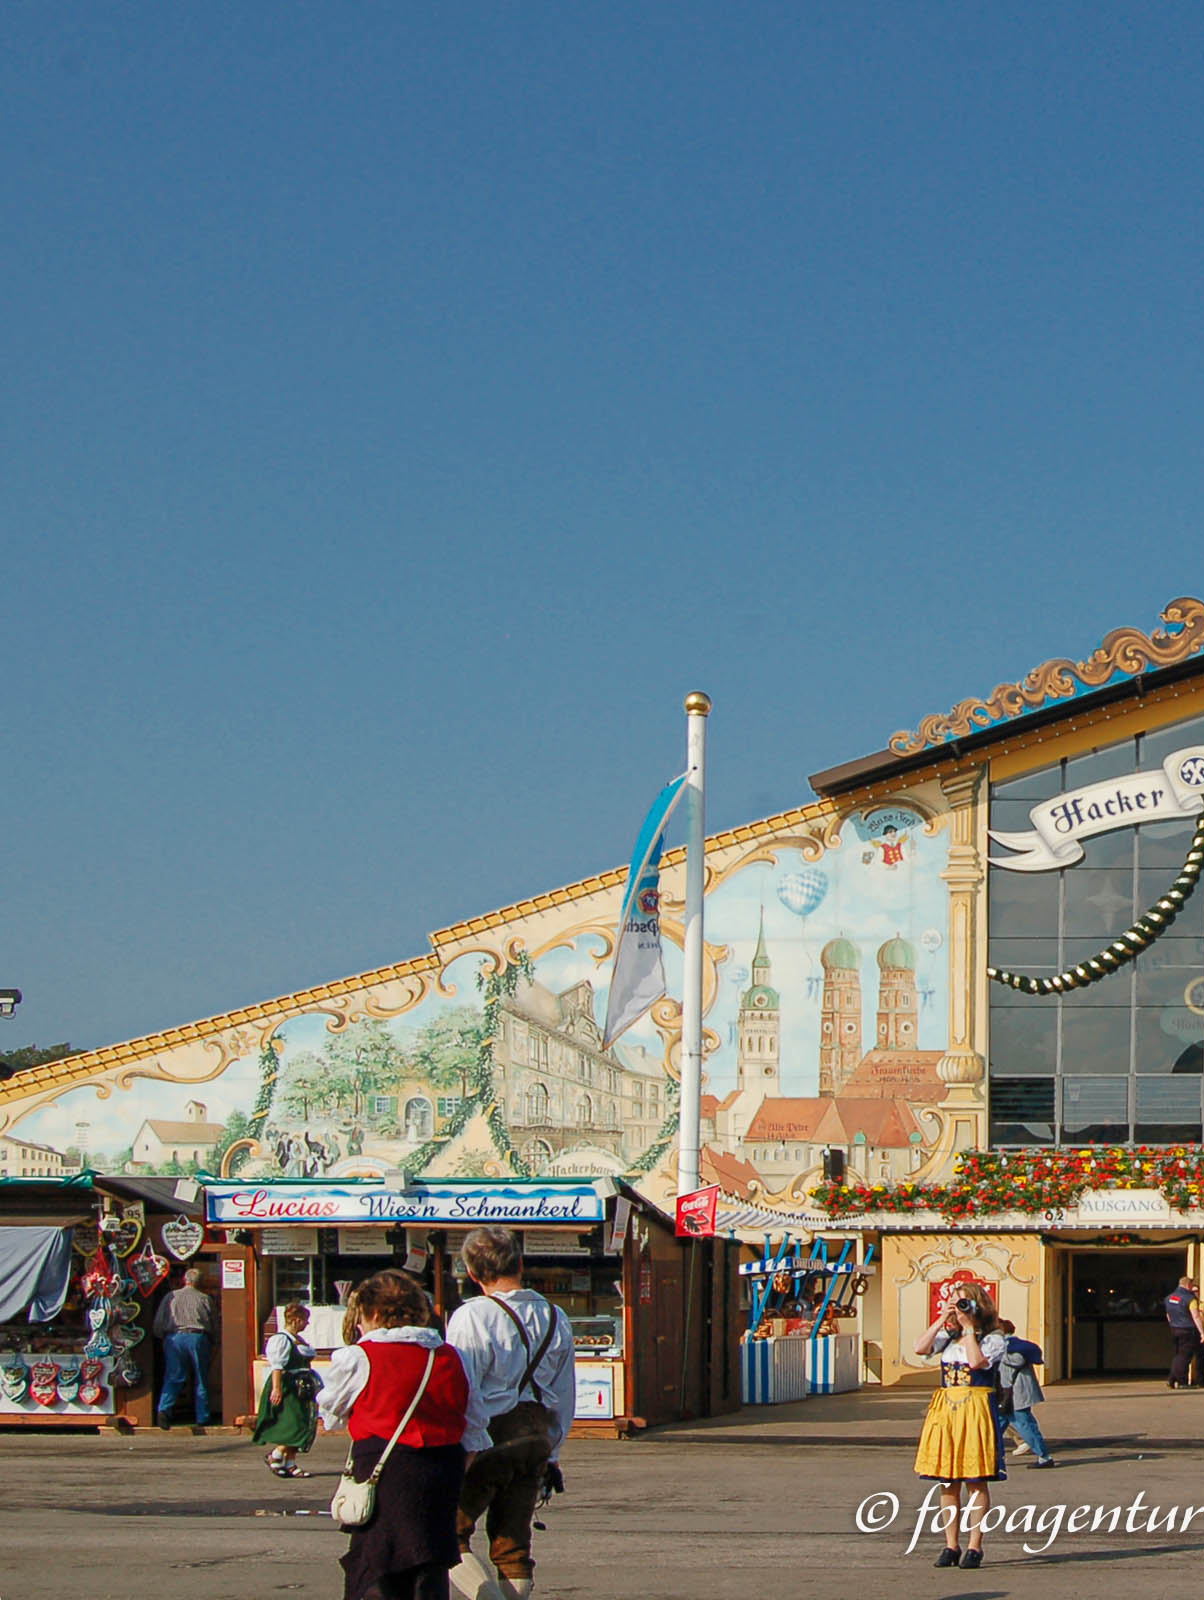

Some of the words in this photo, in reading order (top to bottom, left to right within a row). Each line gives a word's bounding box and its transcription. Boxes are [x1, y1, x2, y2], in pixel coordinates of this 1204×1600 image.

[1050, 786, 1164, 834] Hacker
[232, 1189, 340, 1218] Lucias
[360, 1195, 439, 1217] Wies'n
[449, 1196, 584, 1218] Schmankerl
[1082, 1198, 1163, 1213] AUSGANG
